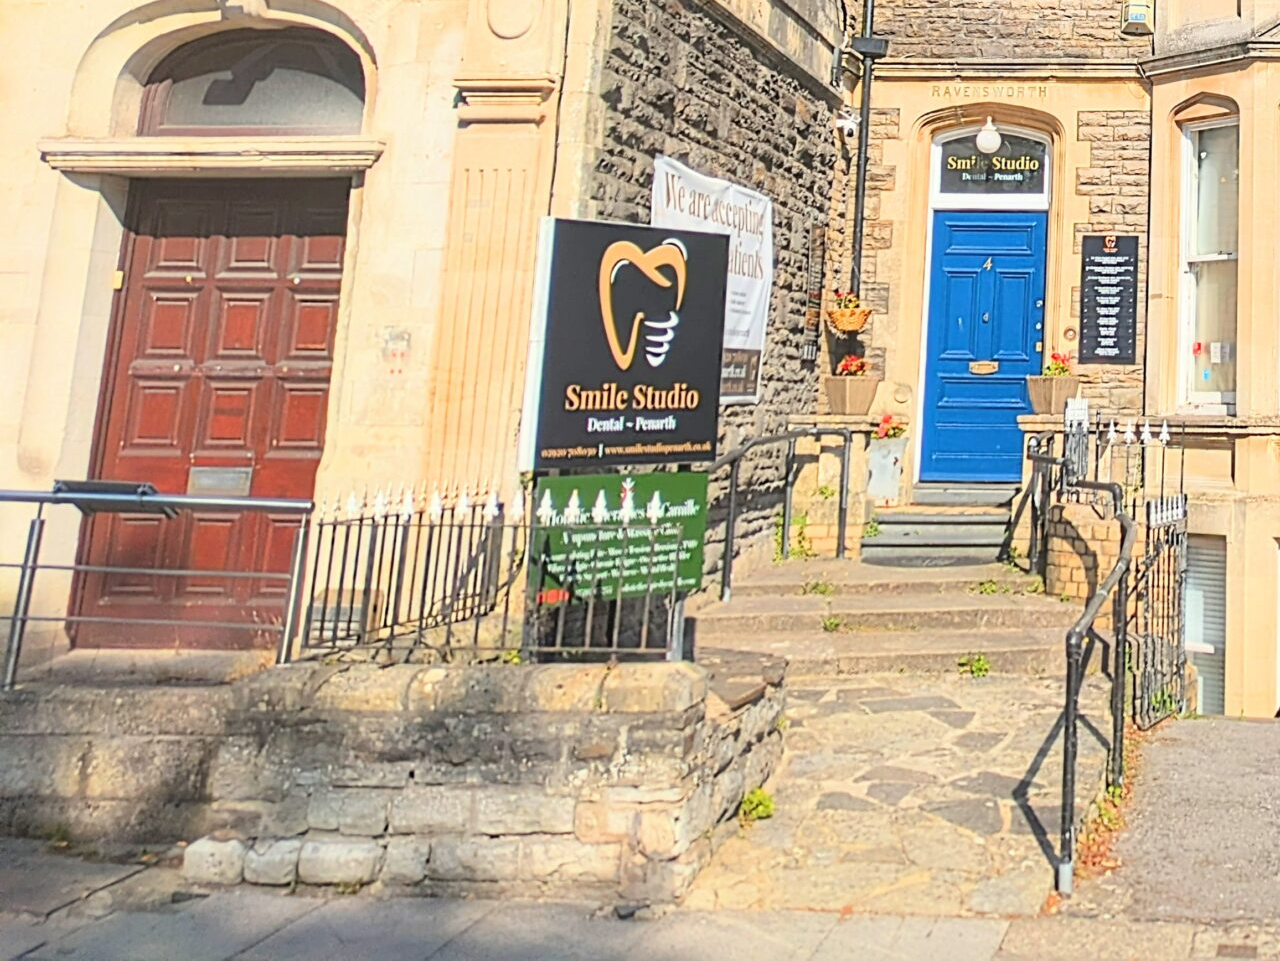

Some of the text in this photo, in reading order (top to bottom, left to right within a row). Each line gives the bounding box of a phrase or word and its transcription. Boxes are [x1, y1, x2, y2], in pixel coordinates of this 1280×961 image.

[931, 85, 1048, 98] RAVENSWORTH
[947, 155, 1040, 170] Smile Studio
[962, 172, 987, 181] Dental
[994, 172, 1024, 181] Penarth
[665, 171, 765, 244] We are accepting
[728, 240, 764, 280] atients
[982, 256, 993, 272] 4
[564, 382, 629, 411] Smile
[632, 382, 700, 411] Studio
[587, 416, 625, 433] Dental
[635, 415, 677, 432] Penarth
